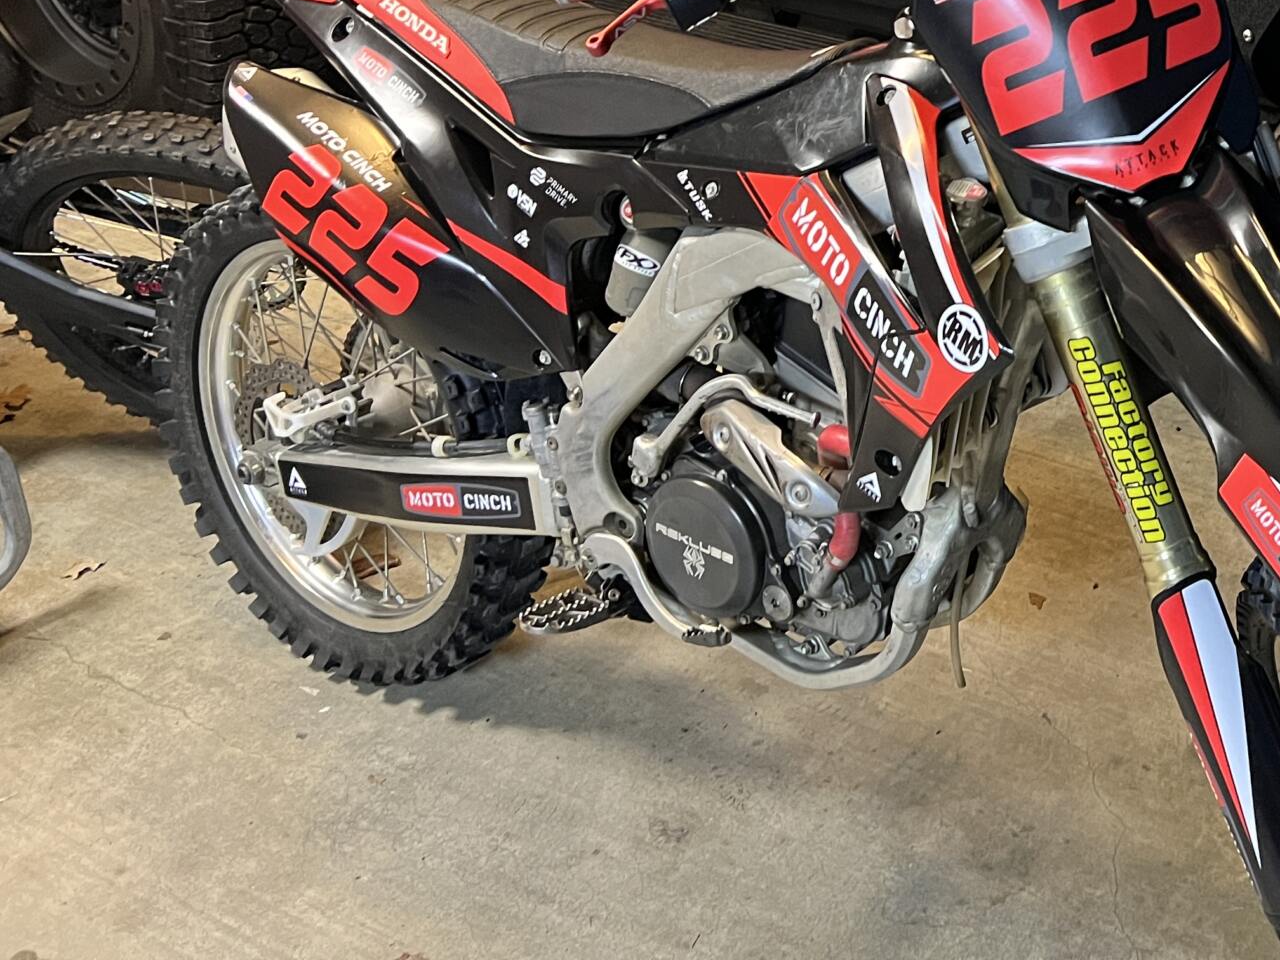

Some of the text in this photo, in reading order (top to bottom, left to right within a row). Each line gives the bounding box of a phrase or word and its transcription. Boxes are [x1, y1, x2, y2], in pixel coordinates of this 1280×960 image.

[357, 50, 422, 104] MOTO CINCH
[297, 112, 392, 193] MOTO CINCH
[546, 176, 578, 204] PRIMARY
[683, 180, 713, 223] TUSK
[262, 144, 450, 316] 225
[791, 196, 915, 378] MOTO CINCH
[944, 316, 984, 367] RM
[1101, 360, 1174, 507] Factory
[408, 490, 512, 512] MOTO CINCH
